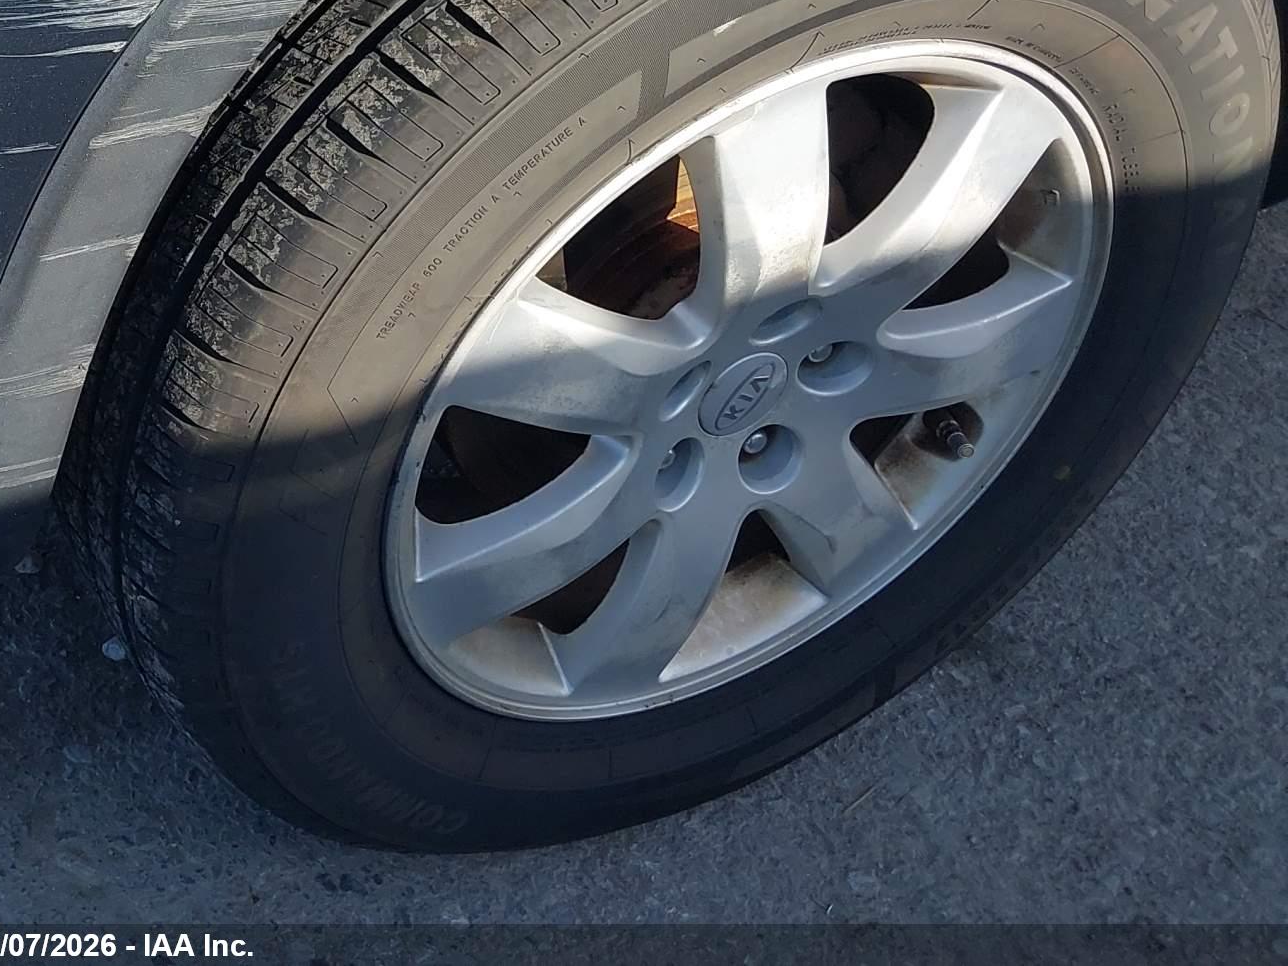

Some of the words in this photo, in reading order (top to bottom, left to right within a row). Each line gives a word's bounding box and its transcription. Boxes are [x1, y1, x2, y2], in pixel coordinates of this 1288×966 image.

[375, 282, 423, 341] TREADWEAR
[422, 256, 443, 278] 600
[443, 205, 489, 254] TRACTION
[491, 194, 501, 204] A
[501, 127, 574, 192] TEMPERATURE
[577, 116, 588, 127] A
[723, 375, 770, 421] KIA
